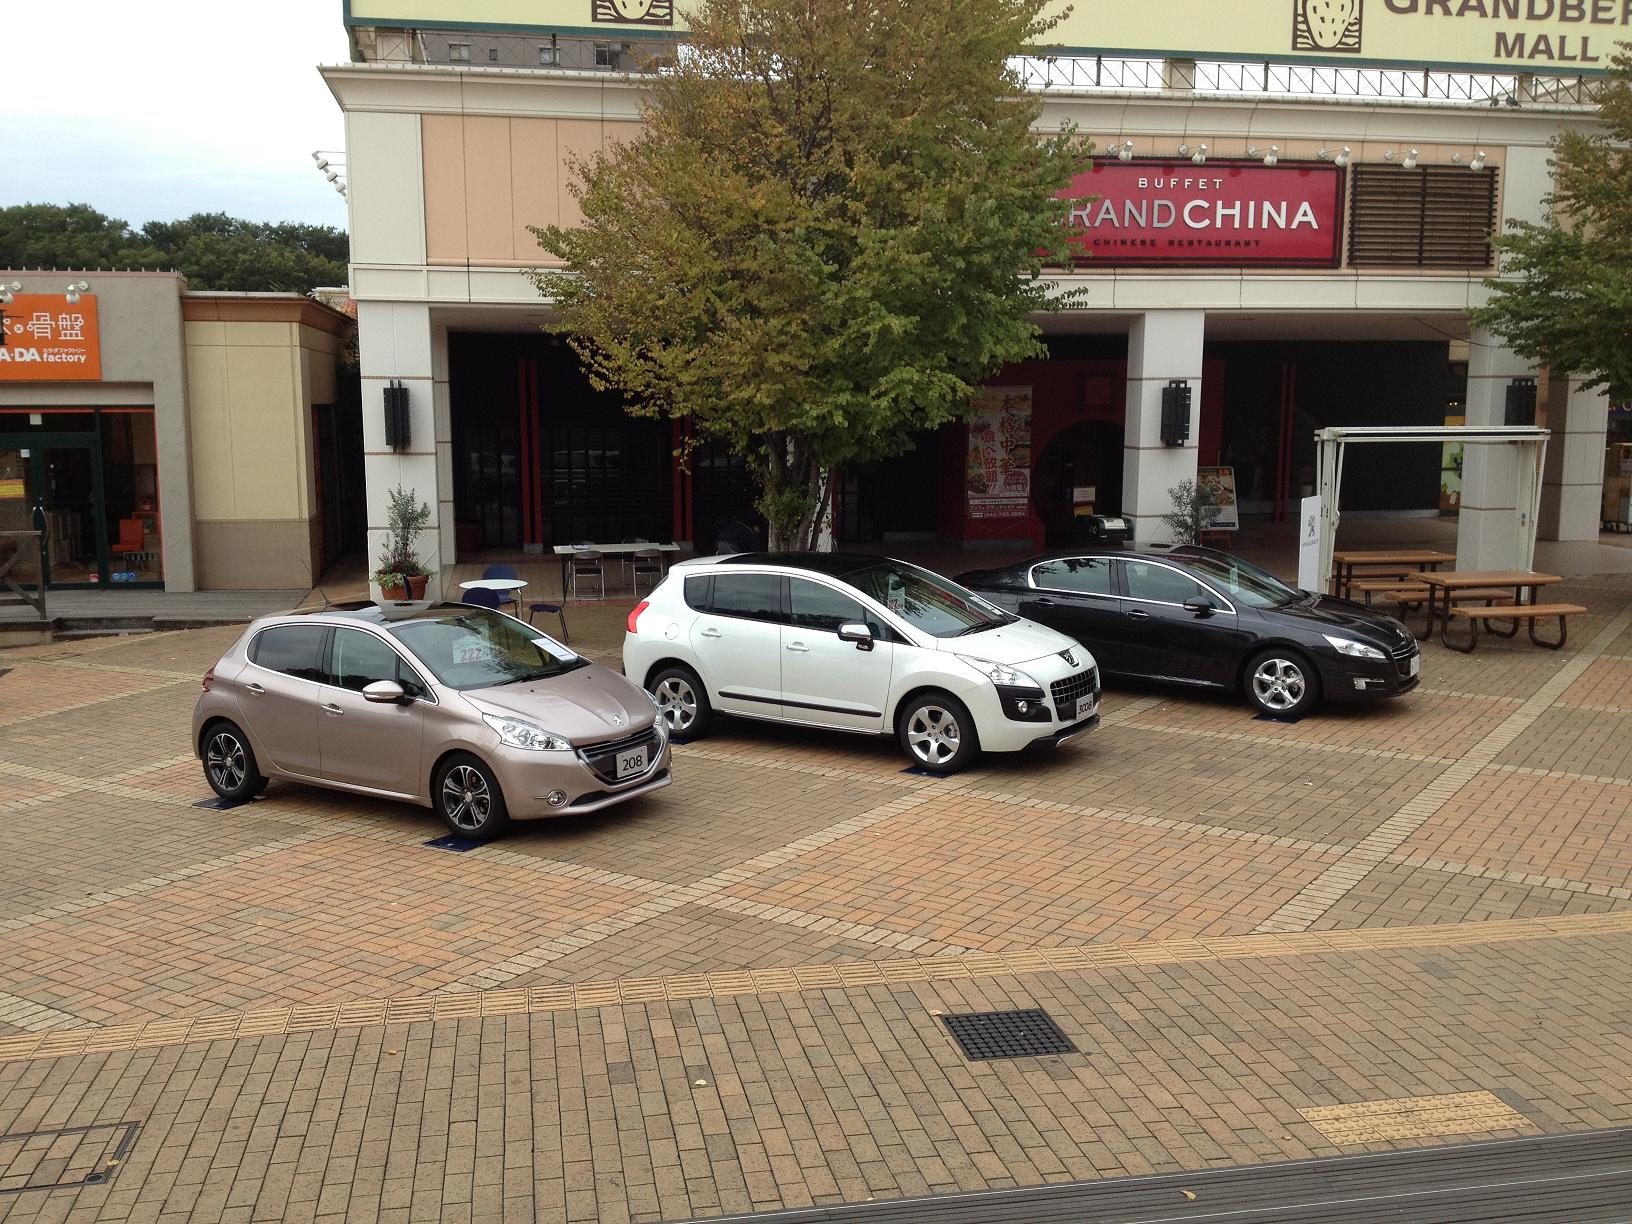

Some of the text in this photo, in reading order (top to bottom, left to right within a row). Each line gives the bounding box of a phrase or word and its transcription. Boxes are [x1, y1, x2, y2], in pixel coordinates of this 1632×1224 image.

[1494, 32, 1599, 61] MALL
[1138, 177, 1223, 189] BUFFET
[1047, 197, 1319, 229] RANDCHINA
[1093, 238, 1261, 248] CHINESE RESTAURANT
[43, 352, 87, 363] factory
[1078, 701, 1092, 714] 3008
[622, 754, 643, 771] 208
